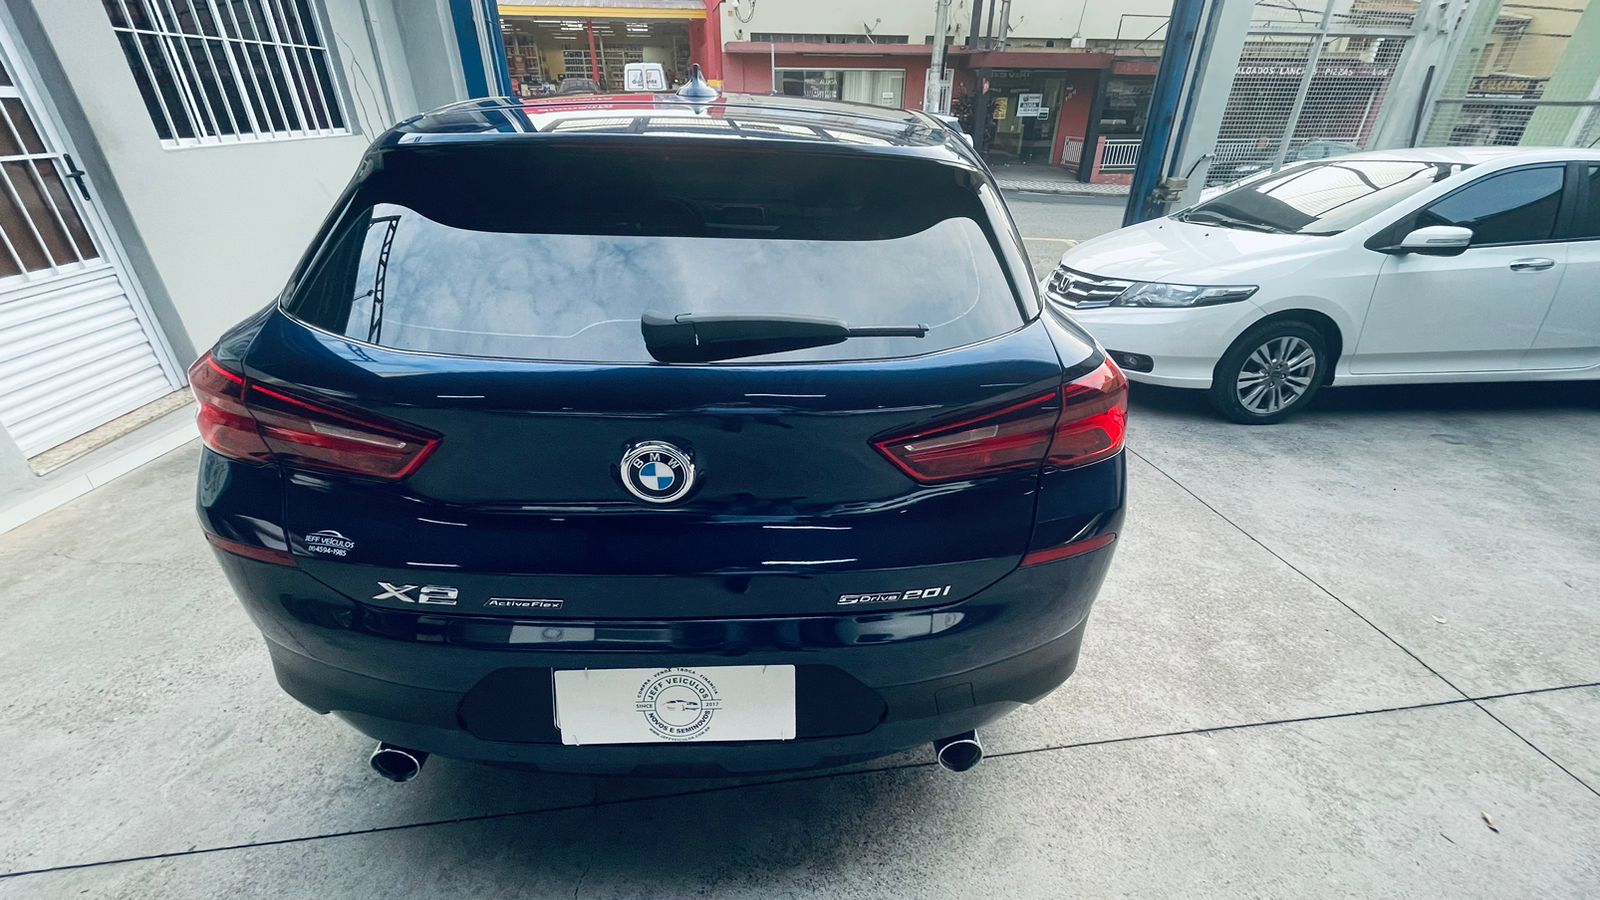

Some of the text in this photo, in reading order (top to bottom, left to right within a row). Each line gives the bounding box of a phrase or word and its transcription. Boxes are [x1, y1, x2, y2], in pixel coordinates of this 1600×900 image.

[1236, 67, 1275, 76] ALGADOS
[1325, 68, 1354, 76] PIZZAS
[633, 452, 680, 469] BMW
[372, 581, 459, 606] X2
[488, 599, 560, 608] ActiveFlex
[677, 667, 696, 675] TROCA
[647, 677, 709, 700] JEFF VEÍCULOS
[648, 712, 668, 731] NOVOS
[676, 710, 711, 734] SEMINOVOS
